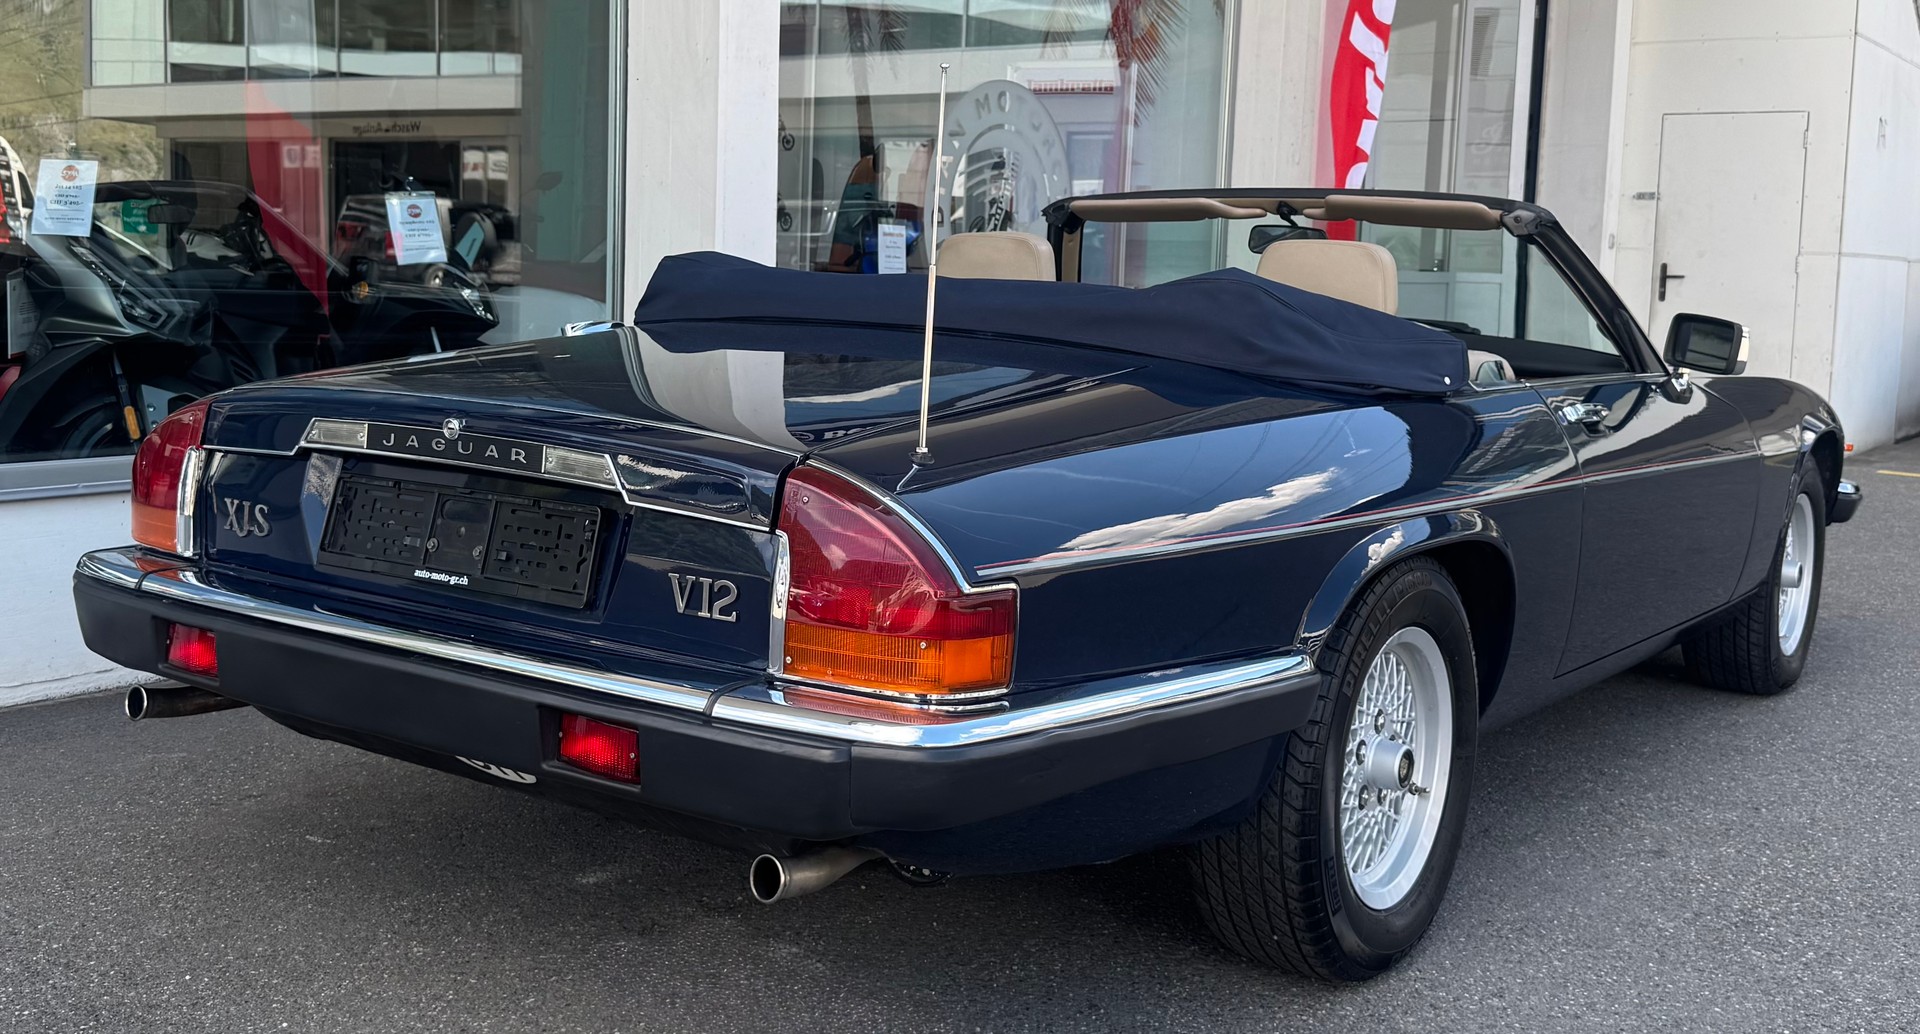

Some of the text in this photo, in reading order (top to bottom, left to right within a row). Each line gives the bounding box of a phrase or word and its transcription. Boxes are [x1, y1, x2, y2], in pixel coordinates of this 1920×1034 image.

[382, 433, 527, 463] JAGUAR
[414, 569, 469, 585] auto-moto-gr.ch
[668, 573, 737, 622] V12
[1342, 602, 1391, 697] PIRELLI
